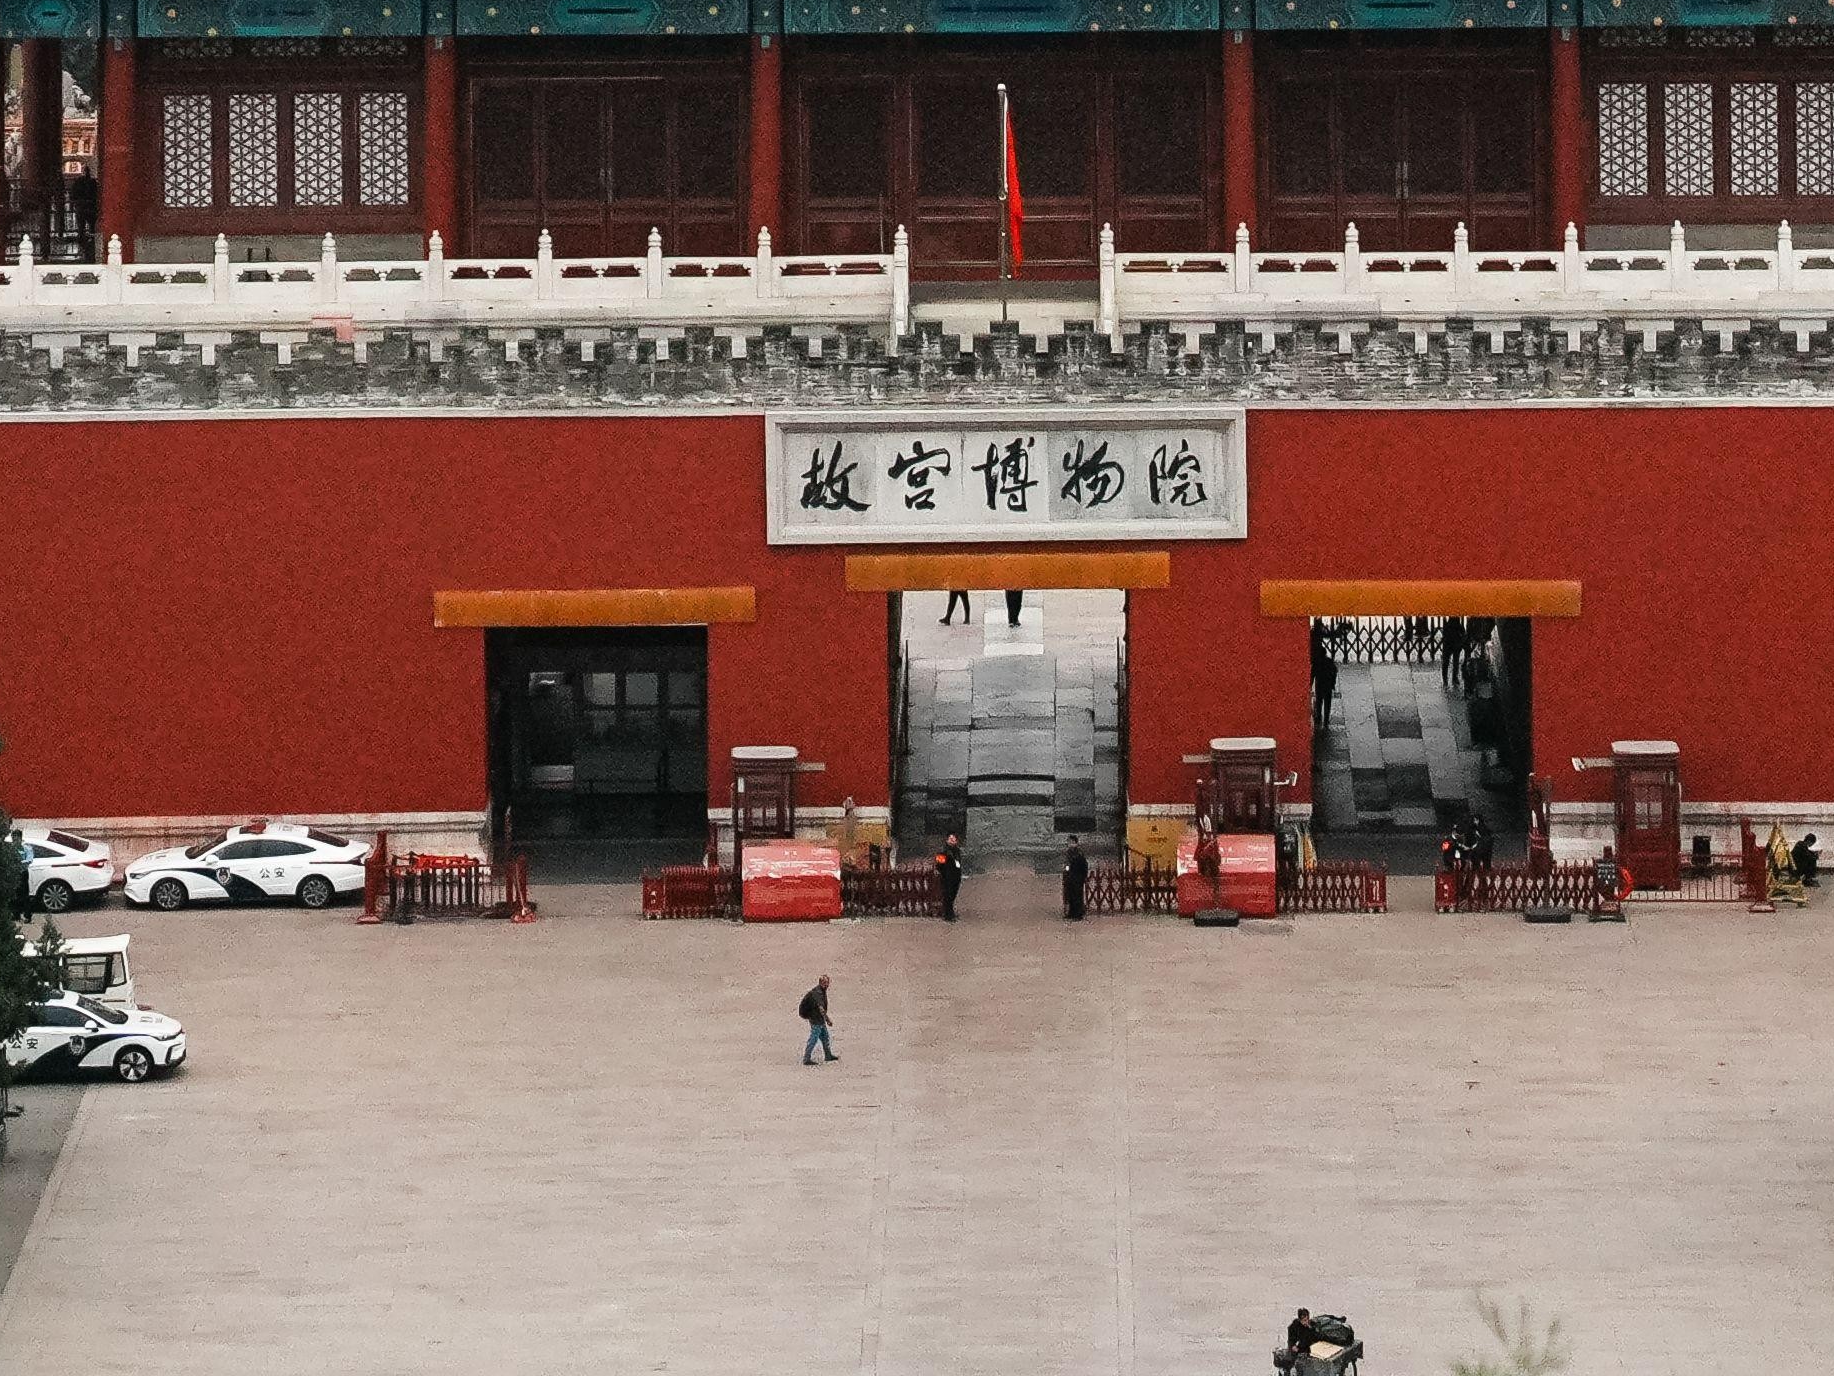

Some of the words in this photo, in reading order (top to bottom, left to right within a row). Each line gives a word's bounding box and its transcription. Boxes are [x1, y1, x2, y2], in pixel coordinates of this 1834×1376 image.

[800, 436, 1209, 512] 故宫博物院
[259, 867, 286, 879] 公安
